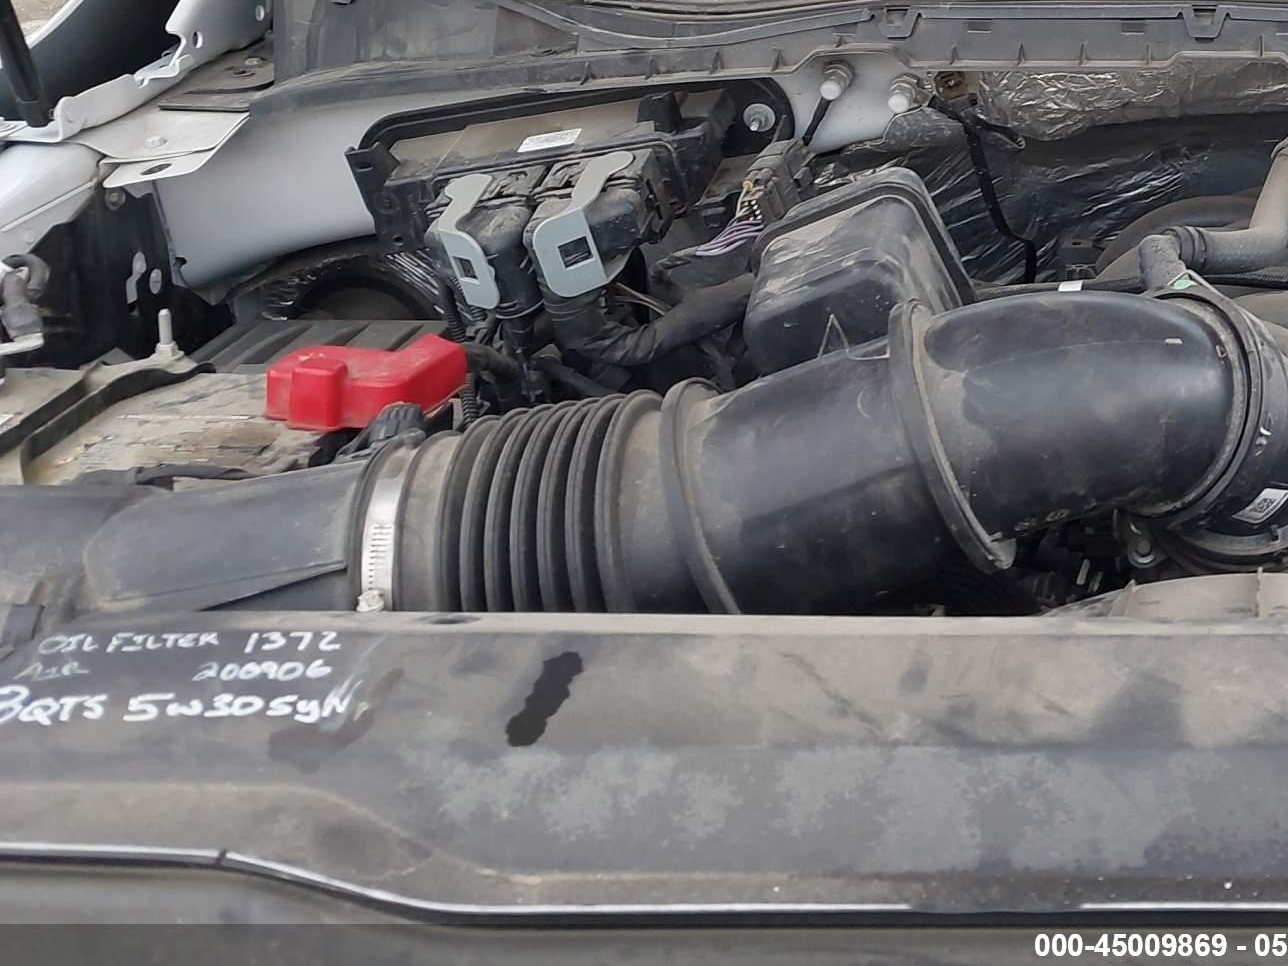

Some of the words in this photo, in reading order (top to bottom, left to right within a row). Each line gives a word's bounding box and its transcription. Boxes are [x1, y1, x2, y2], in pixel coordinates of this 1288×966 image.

[38, 632, 99, 655] OIL
[106, 631, 220, 653] FILTER
[244, 631, 341, 654] 1372
